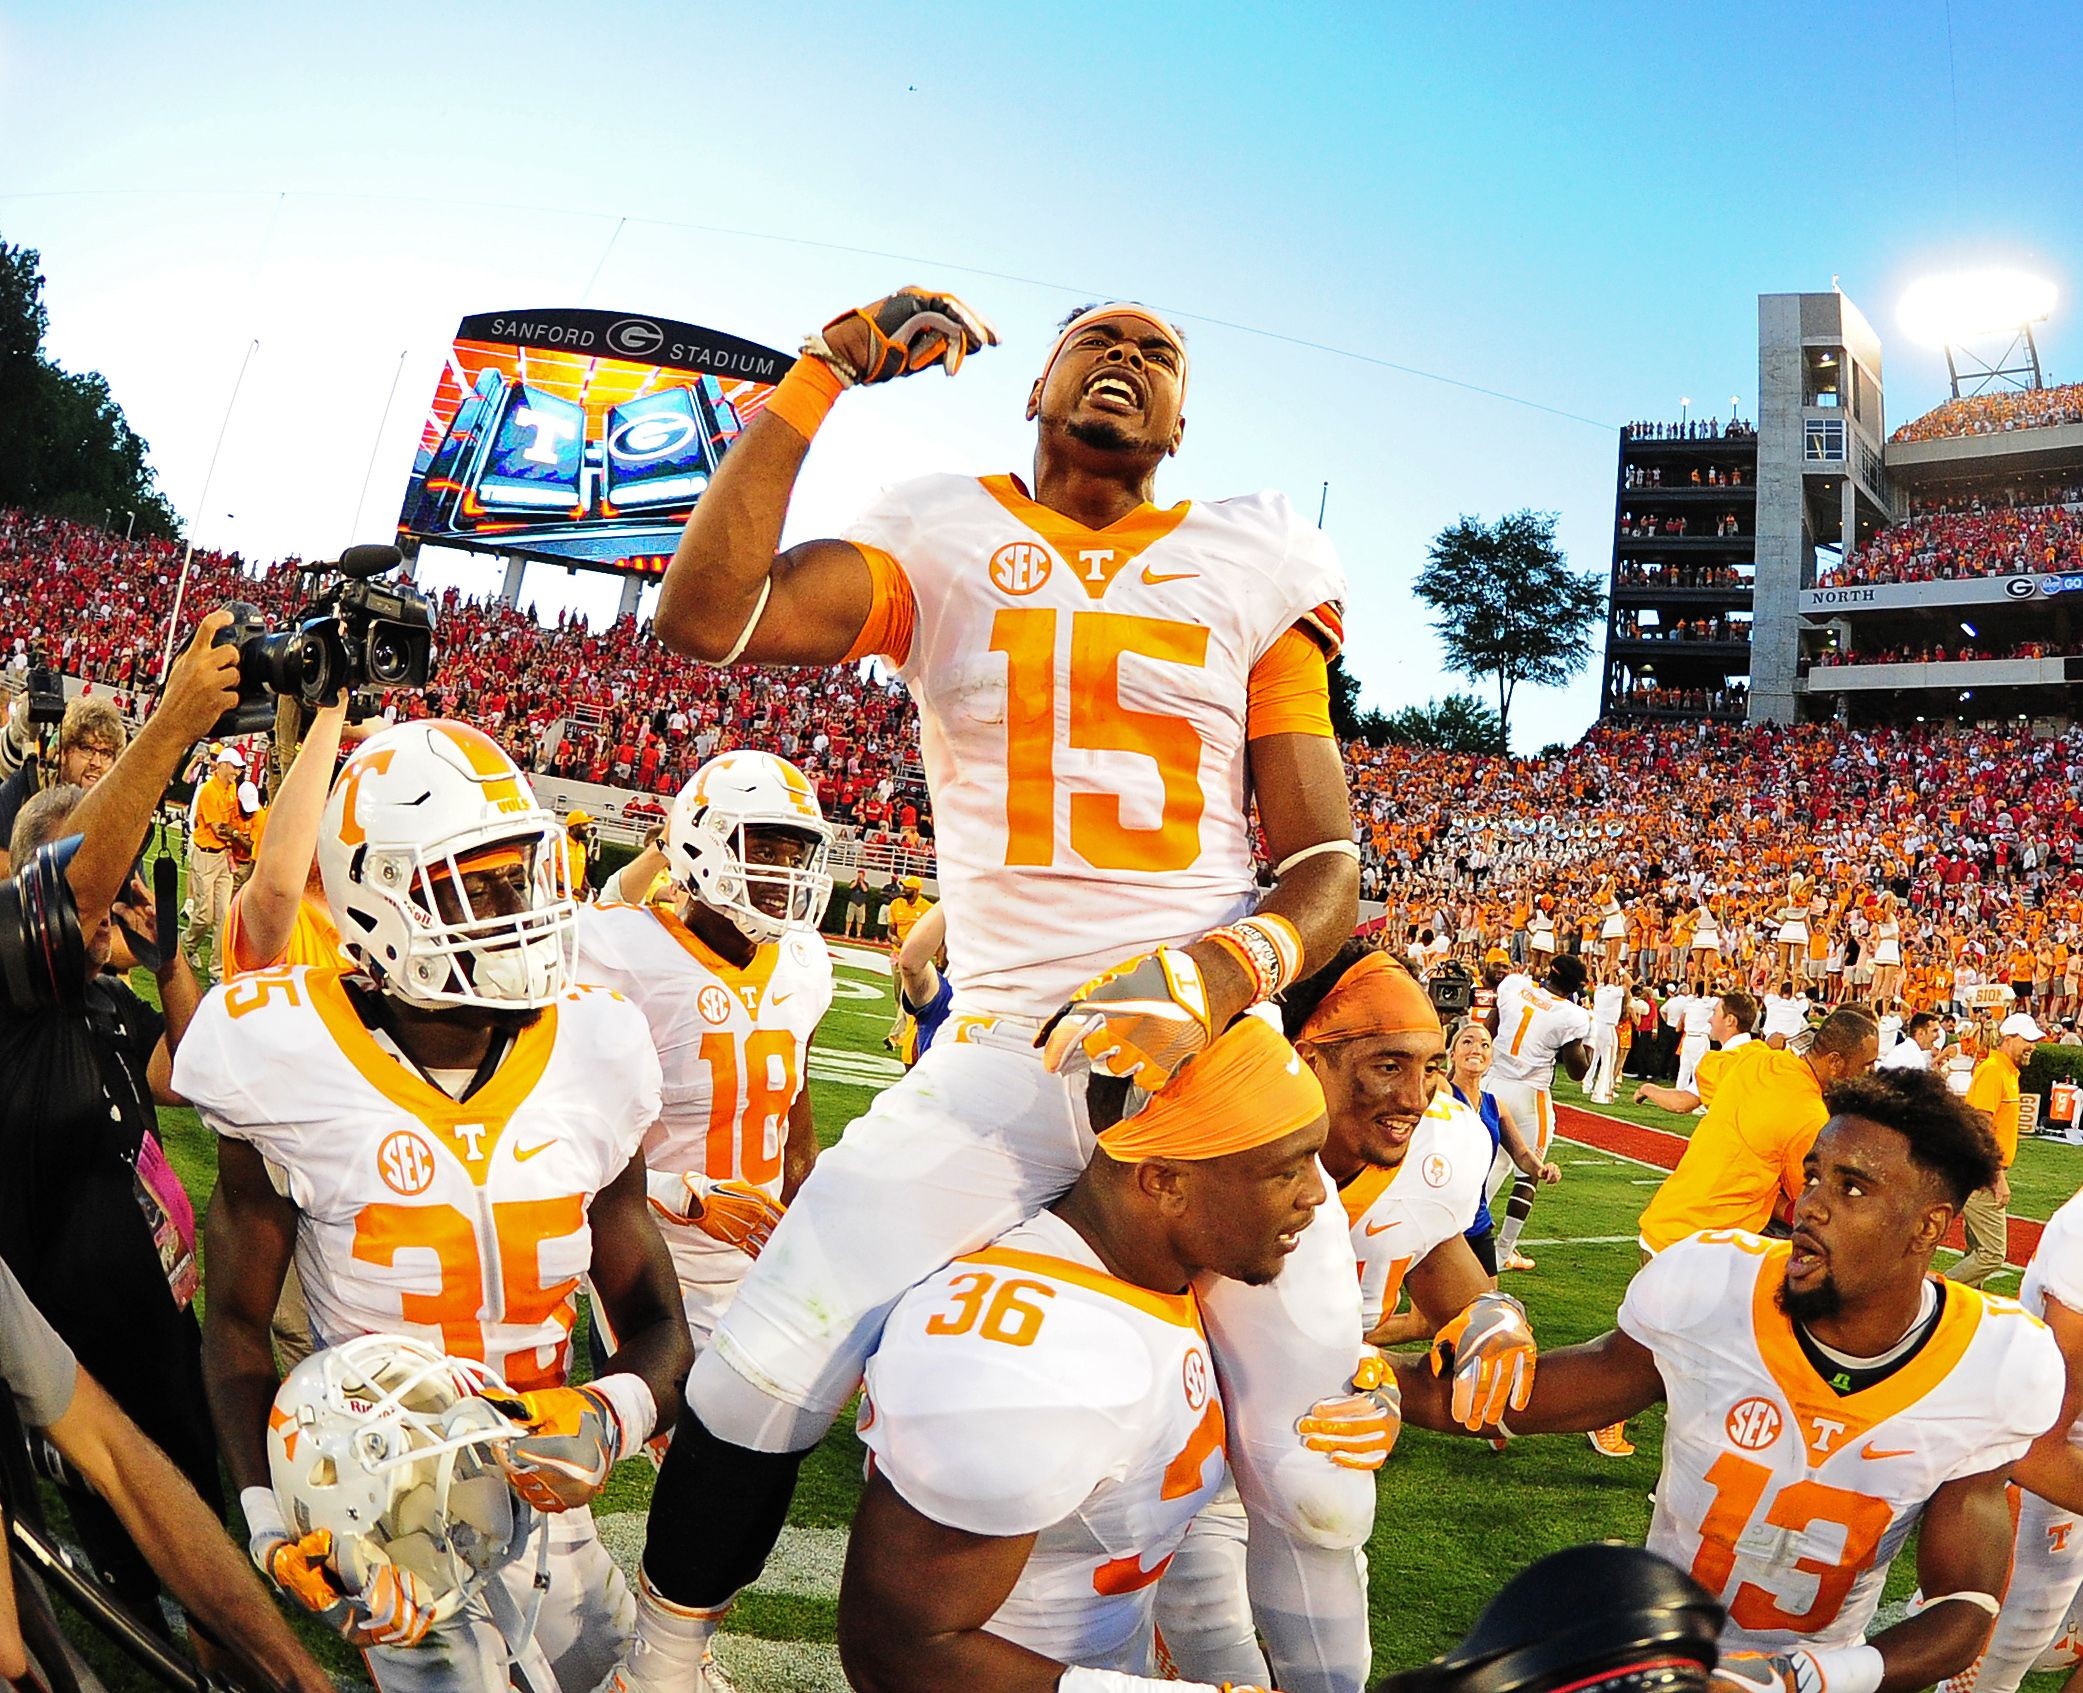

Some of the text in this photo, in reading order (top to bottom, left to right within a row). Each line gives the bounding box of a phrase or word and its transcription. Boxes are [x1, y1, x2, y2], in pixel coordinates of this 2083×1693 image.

[490, 318, 595, 348] SANFORD
[668, 343, 776, 376] STADIUM
[514, 407, 577, 465] T
[995, 543, 1048, 593] SEC
[1078, 549, 1114, 580] T
[1812, 588, 1876, 605] NORTH
[988, 607, 1211, 871] 15
[332, 749, 397, 847] T
[700, 989, 729, 1021] SEC
[739, 986, 758, 1009] T
[1510, 1005, 1534, 1056] 1
[699, 1029, 797, 1186] 18
[2018, 1095, 2036, 1131] GOOD
[381, 1134, 432, 1191] SEC
[454, 1123, 487, 1161] T
[352, 1191, 588, 1393] 35
[924, 1271, 1057, 1347] 36
[1729, 1400, 1779, 1448] SEC
[1811, 1416, 1846, 1452] T
[1688, 1450, 1895, 1634] 13
[2048, 1522, 2074, 1552] T
